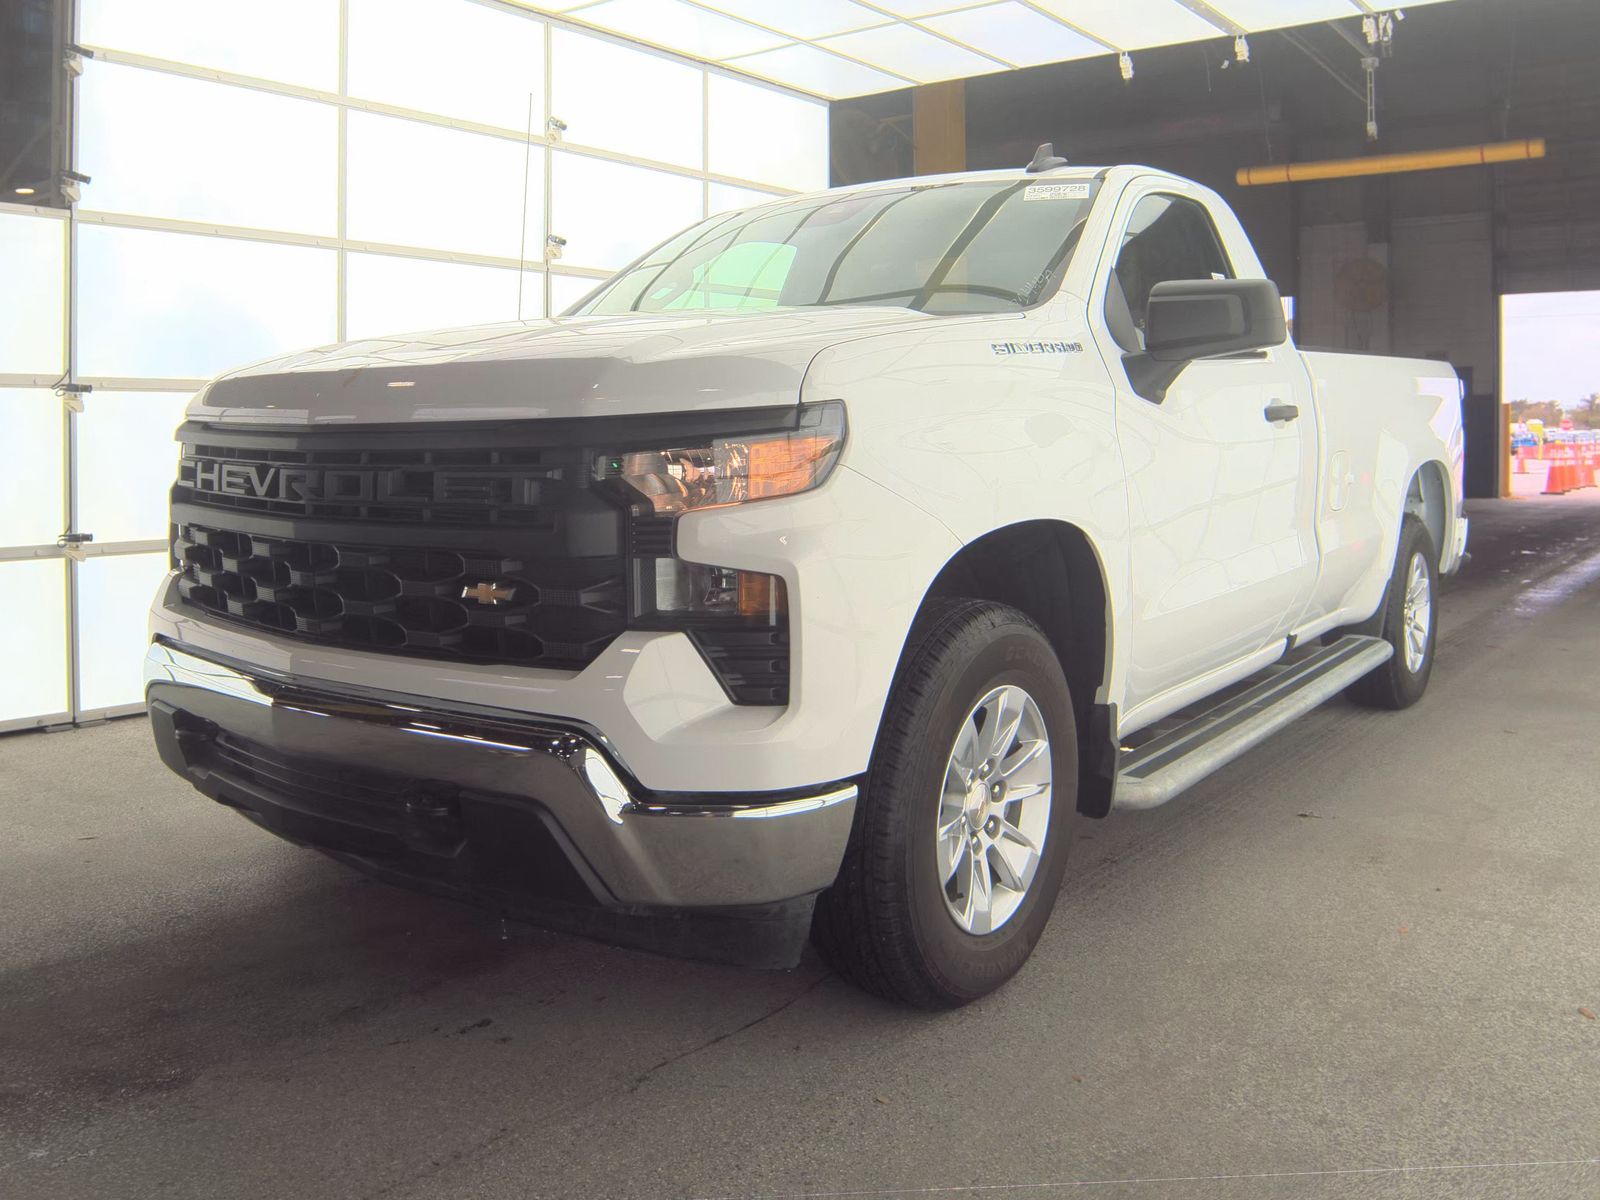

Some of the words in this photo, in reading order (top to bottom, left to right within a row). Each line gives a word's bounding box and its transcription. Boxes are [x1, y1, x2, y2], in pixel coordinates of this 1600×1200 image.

[1028, 185, 1086, 194] 3599728
[991, 342, 1083, 355] SILVERADO
[176, 460, 562, 506] CHEVROLET
